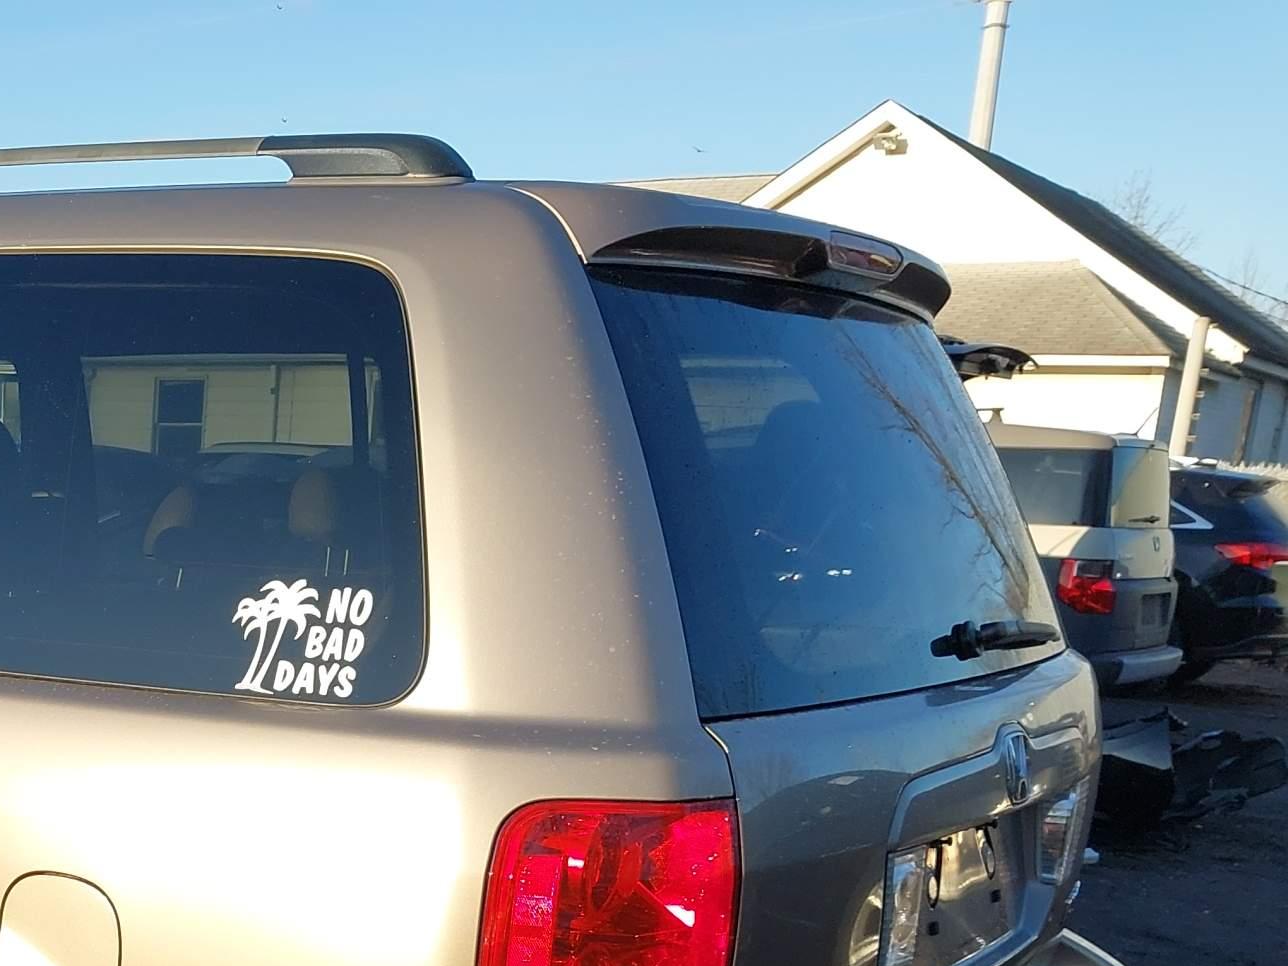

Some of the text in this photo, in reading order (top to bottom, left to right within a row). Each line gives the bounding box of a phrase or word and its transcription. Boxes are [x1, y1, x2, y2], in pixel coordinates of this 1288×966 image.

[325, 587, 373, 626] NO
[304, 625, 365, 662] BAD
[273, 660, 357, 698] DAYS
